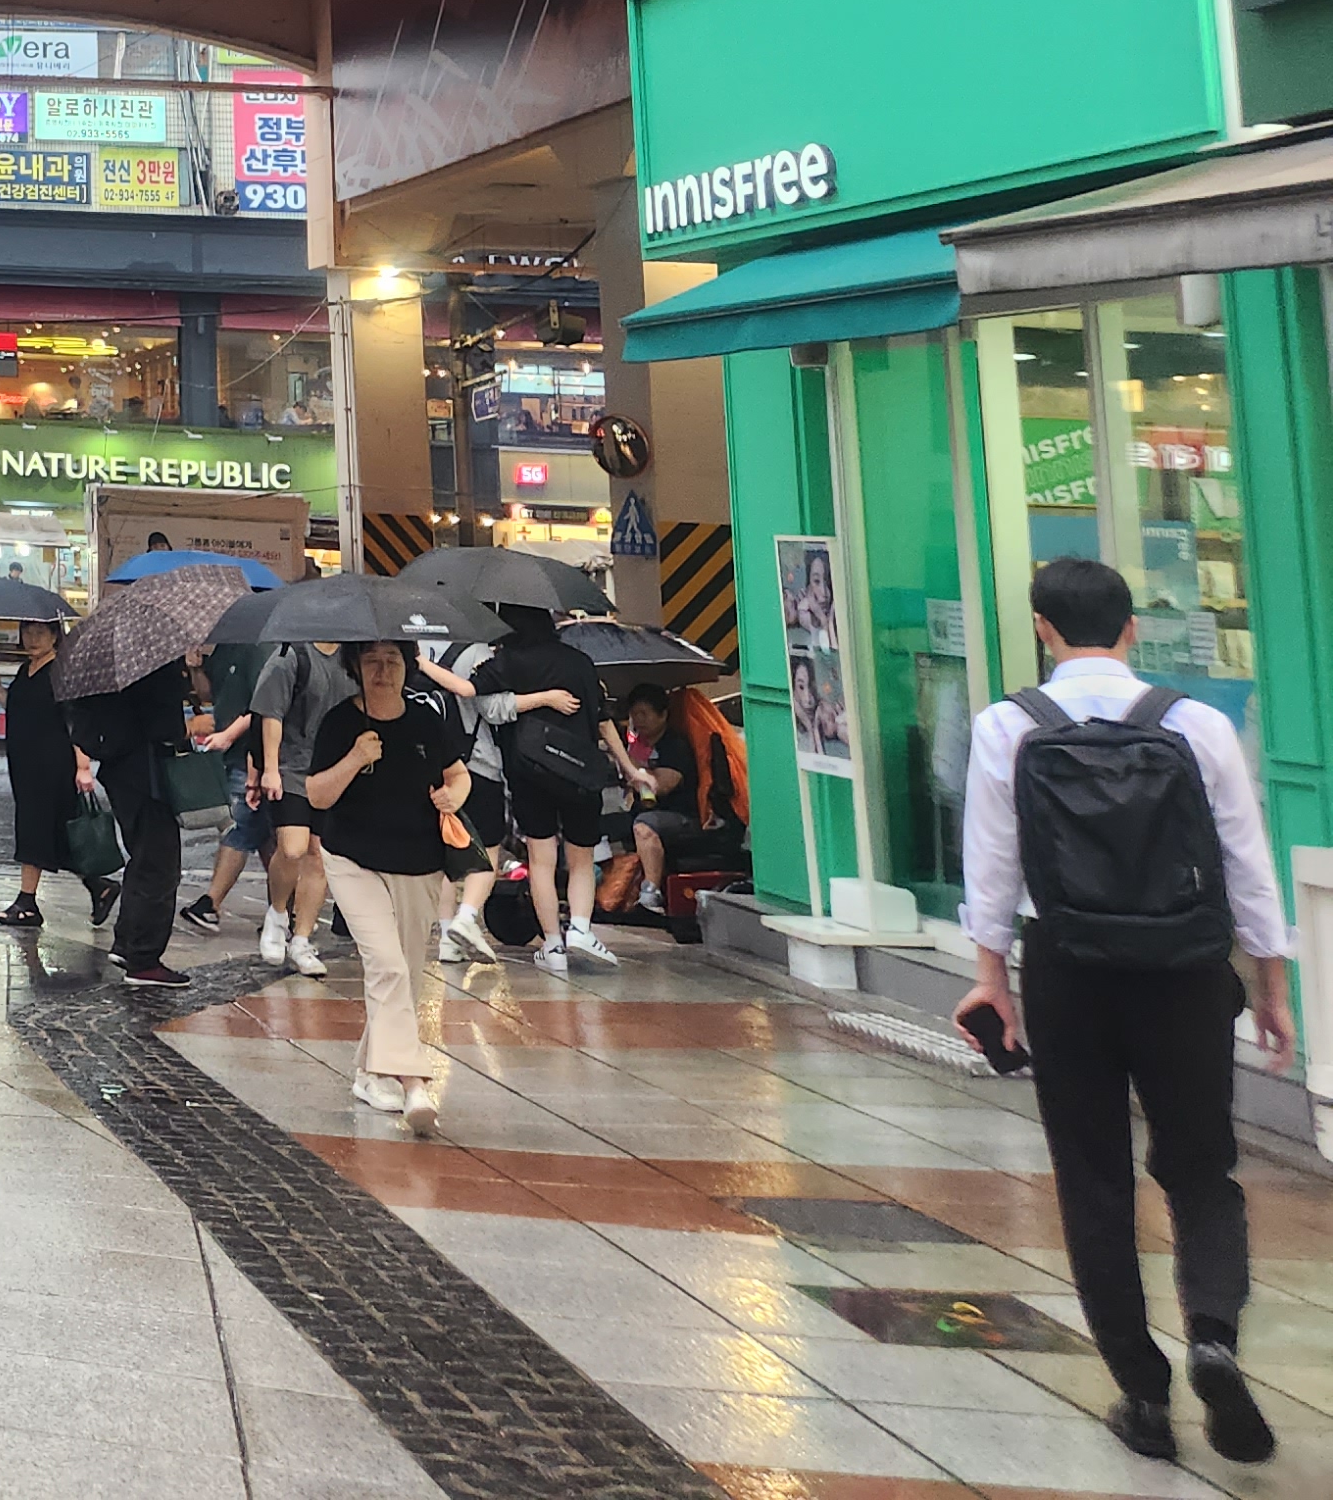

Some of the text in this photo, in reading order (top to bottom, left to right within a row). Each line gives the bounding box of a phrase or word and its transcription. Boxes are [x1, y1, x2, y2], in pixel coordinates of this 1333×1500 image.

[46, 97, 154, 120] 알로하사진관
[74, 154, 88, 183] 의원
[103, 159, 176, 186] 전신 3만원
[243, 147, 307, 175] 산후
[0, 450, 292, 490] NATURE REPUBLIC
